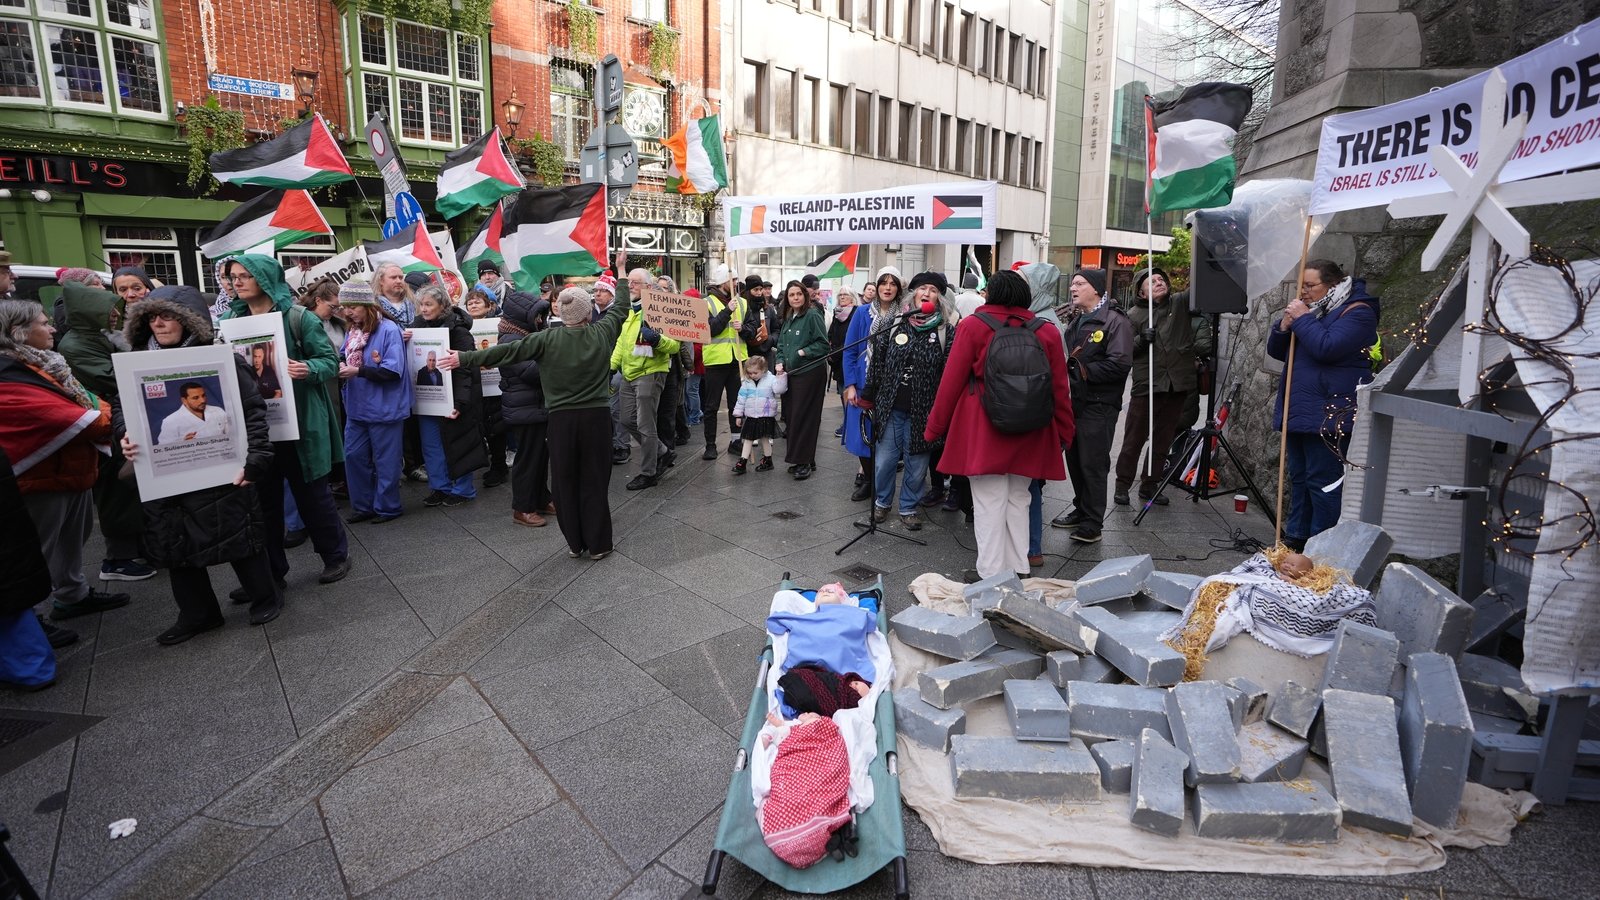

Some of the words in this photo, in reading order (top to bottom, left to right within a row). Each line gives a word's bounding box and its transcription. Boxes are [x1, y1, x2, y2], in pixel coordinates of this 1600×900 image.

[250, 87, 275, 96] STREET
[284, 88, 290, 96] 2
[1090, 92, 1100, 161] STREET
[1336, 113, 1431, 168] THERE
[1441, 102, 1473, 146] IS
[1502, 81, 1536, 130] O
[1329, 171, 1373, 193] ISRAEL
[1375, 168, 1392, 187] IS
[1391, 162, 1427, 185] STILL
[1509, 134, 1541, 161] ND
[779, 195, 915, 215] IRELAND-PALESTINE
[769, 217, 845, 234] SOLIDARITY
[848, 215, 925, 232] CAMPAIGN
[649, 293, 691, 308] TERMINATE
[648, 303, 660, 312] ALL
[662, 305, 697, 319] CONTRACTS
[646, 313, 662, 323] THAT
[664, 316, 690, 328] SUPPORT
[668, 327, 700, 340] GENOCIDE
[146, 384, 164, 392] 607
